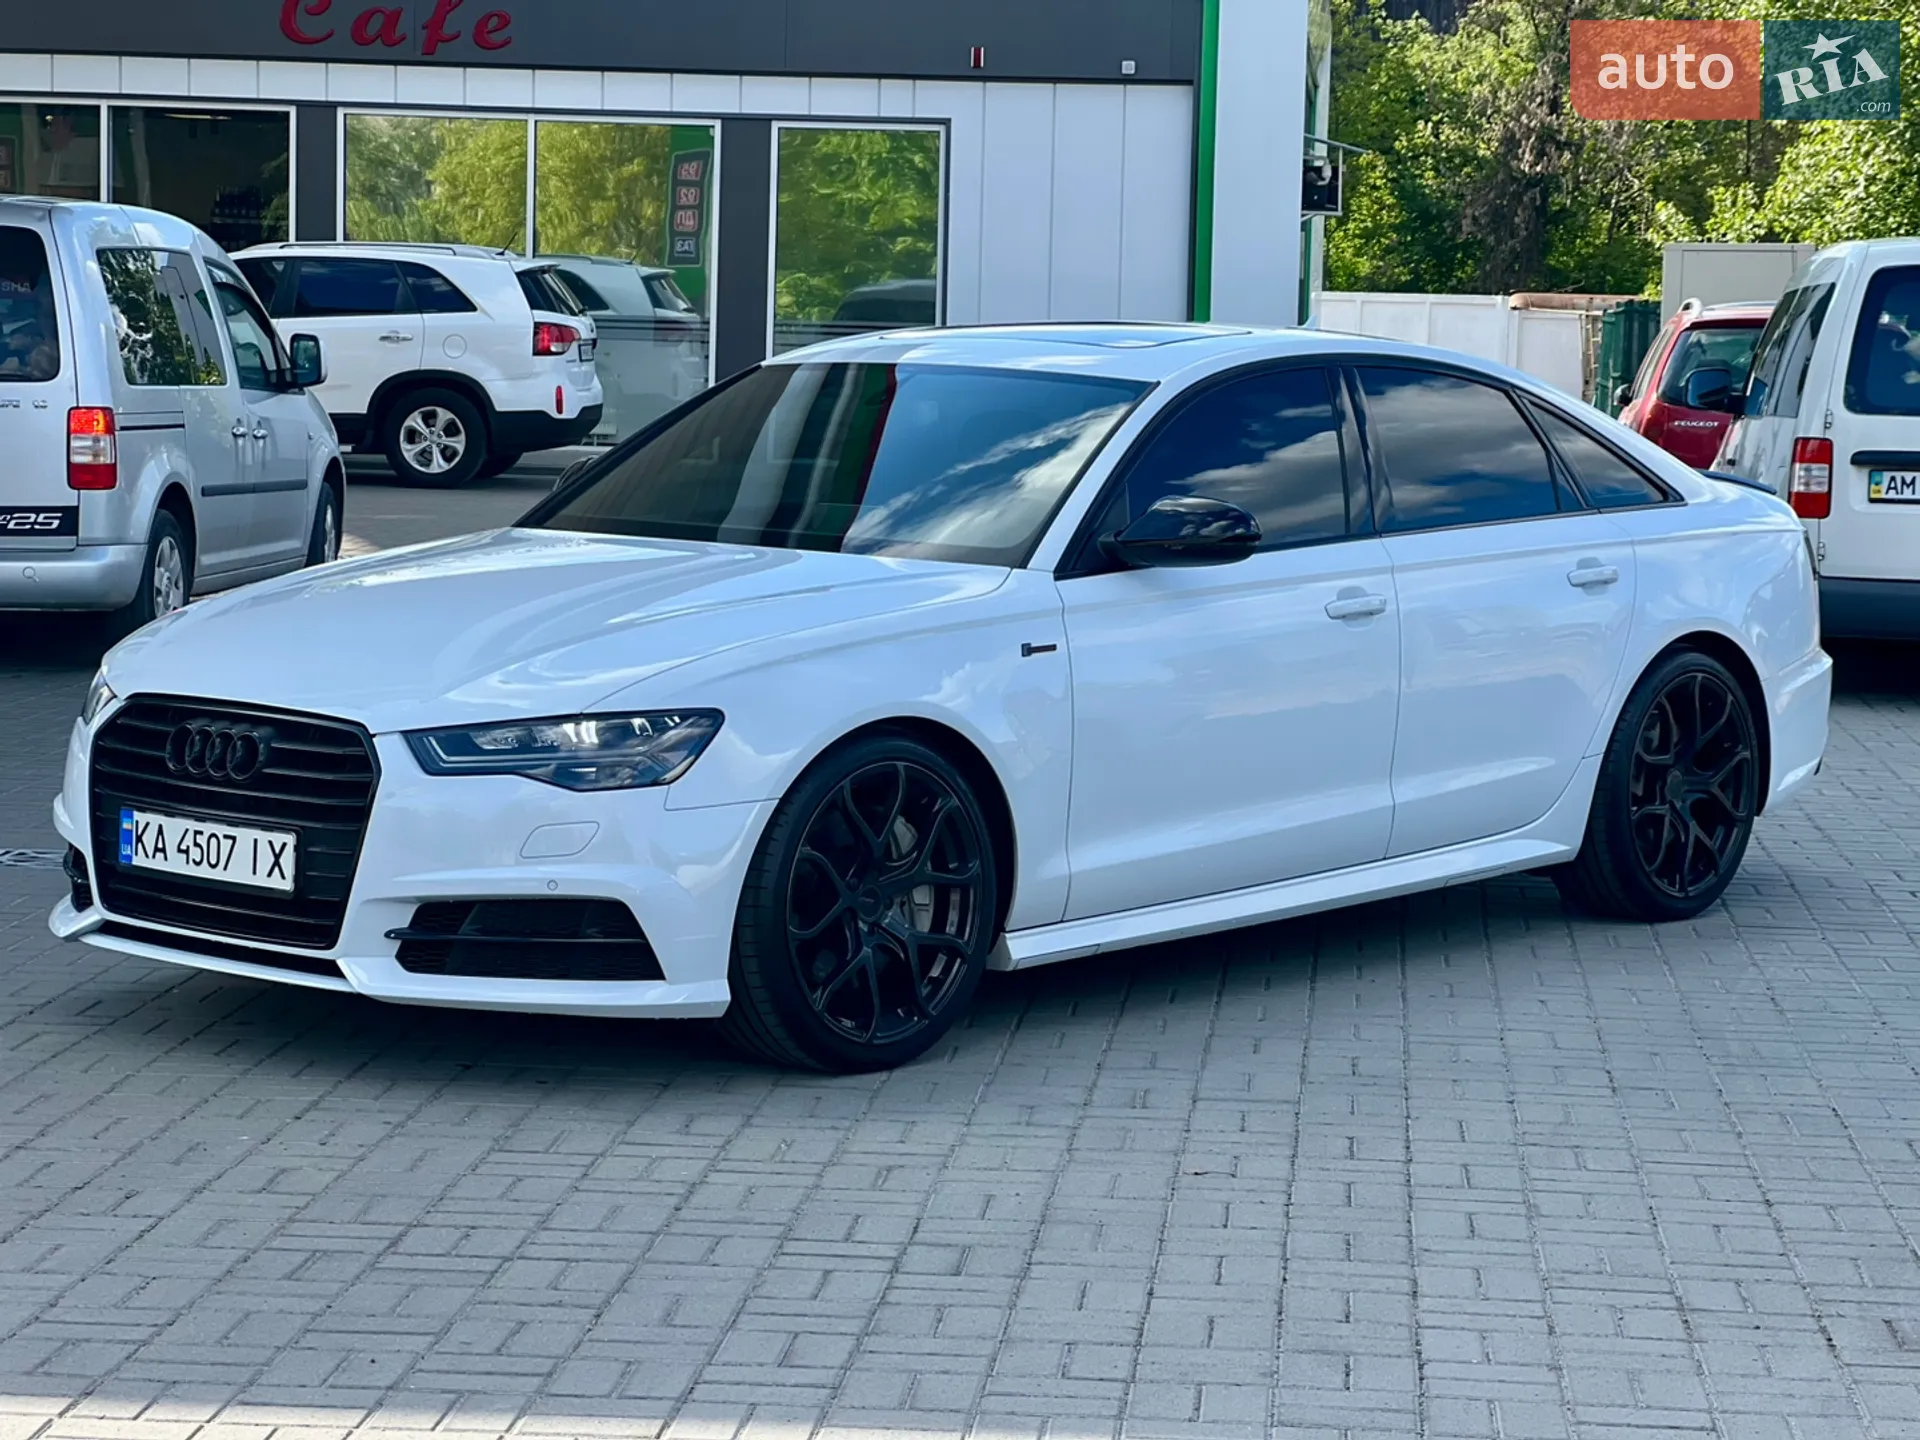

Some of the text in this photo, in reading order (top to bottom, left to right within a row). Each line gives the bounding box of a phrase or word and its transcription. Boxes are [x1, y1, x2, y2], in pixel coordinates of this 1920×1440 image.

[279, 0, 512, 55] Cafe
[1674, 420, 1719, 428] PEUGEOT
[1885, 475, 1916, 495] AM
[122, 844, 132, 856] UA
[135, 820, 288, 880] KA 4507 IX
